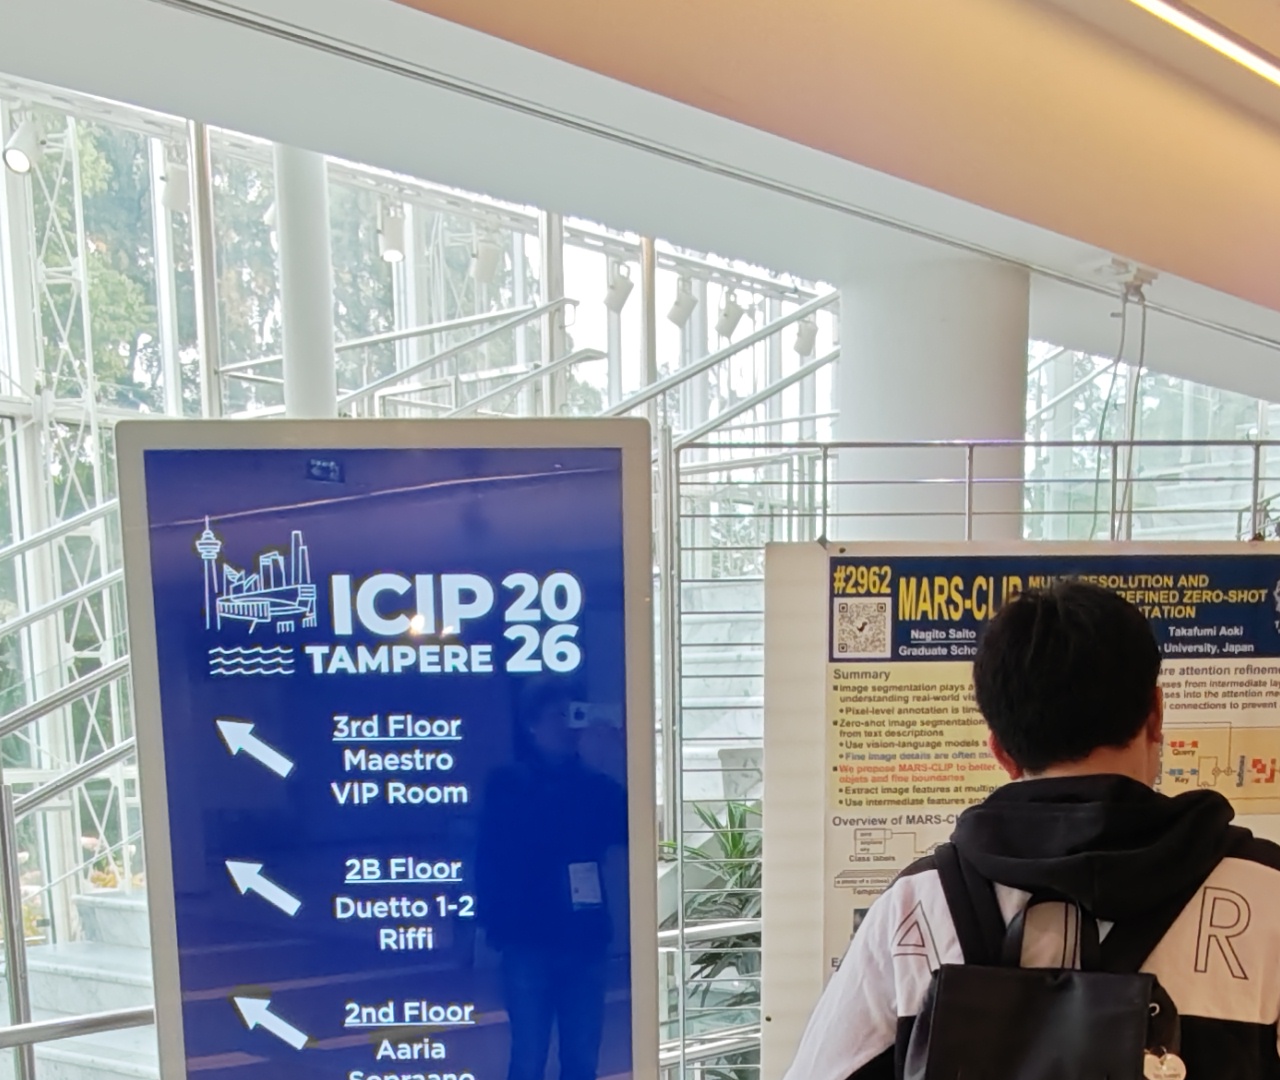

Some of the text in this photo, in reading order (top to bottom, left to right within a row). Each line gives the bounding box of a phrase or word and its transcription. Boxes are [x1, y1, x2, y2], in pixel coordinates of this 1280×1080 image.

[833, 565, 892, 594] #2962
[1028, 574, 1209, 588] MUESOLUTION AND
[501, 572, 582, 622] 20
[898, 575, 1023, 621] MARS-CLIP
[1183, 589, 1269, 604] ZERO-SHOT
[331, 572, 494, 636] ICIP
[910, 626, 1244, 641] Nagito Saito Takafumi Aoki
[503, 624, 581, 673] 26
[899, 643, 1254, 656] Graduate Scho University, Japan
[305, 645, 493, 674] TAMPERE
[833, 668, 890, 681] Summary
[1179, 666, 1231, 676] attention
[840, 684, 869, 693] Image
[871, 683, 937, 693] segmentation
[940, 683, 965, 692] plays
[1185, 680, 1207, 688] from
[1210, 679, 1267, 688] intermediate
[840, 694, 909, 704] understanding
[912, 693, 960, 702] real-world
[1184, 690, 1202, 698] into
[1204, 690, 1219, 698] the
[1222, 690, 1262, 698] attention
[845, 706, 894, 715] Pixel-level
[897, 706, 949, 715] annotation
[951, 706, 960, 714] is
[1169, 701, 1227, 710] connections
[1230, 701, 1239, 709] to
[1241, 701, 1277, 710] prevent
[333, 714, 461, 739] 3rd Floor
[840, 718, 886, 728] Zero-shot
[888, 718, 917, 728] image
[840, 729, 944, 738] from text descriptions
[845, 739, 980, 749] Use vision-language models
[344, 748, 454, 772] Maestro
[839, 764, 854, 772] We
[898, 764, 953, 772] MARS-CLIP
[1174, 776, 1189, 784] Key
[332, 781, 468, 805] VIP Room
[845, 785, 996, 795] Extract image features at multip
[845, 798, 863, 807] Use
[866, 798, 924, 806] intermediate
[927, 797, 965, 805] features
[832, 814, 958, 827] Overview of MARS-C
[345, 856, 463, 881] 2B Floor
[335, 895, 475, 919] Duetto 1-2
[379, 926, 433, 950] Riffi
[1194, 885, 1251, 981] R
[345, 1001, 475, 1024] 2nd Floor
[376, 1038, 446, 1060] Aaria
